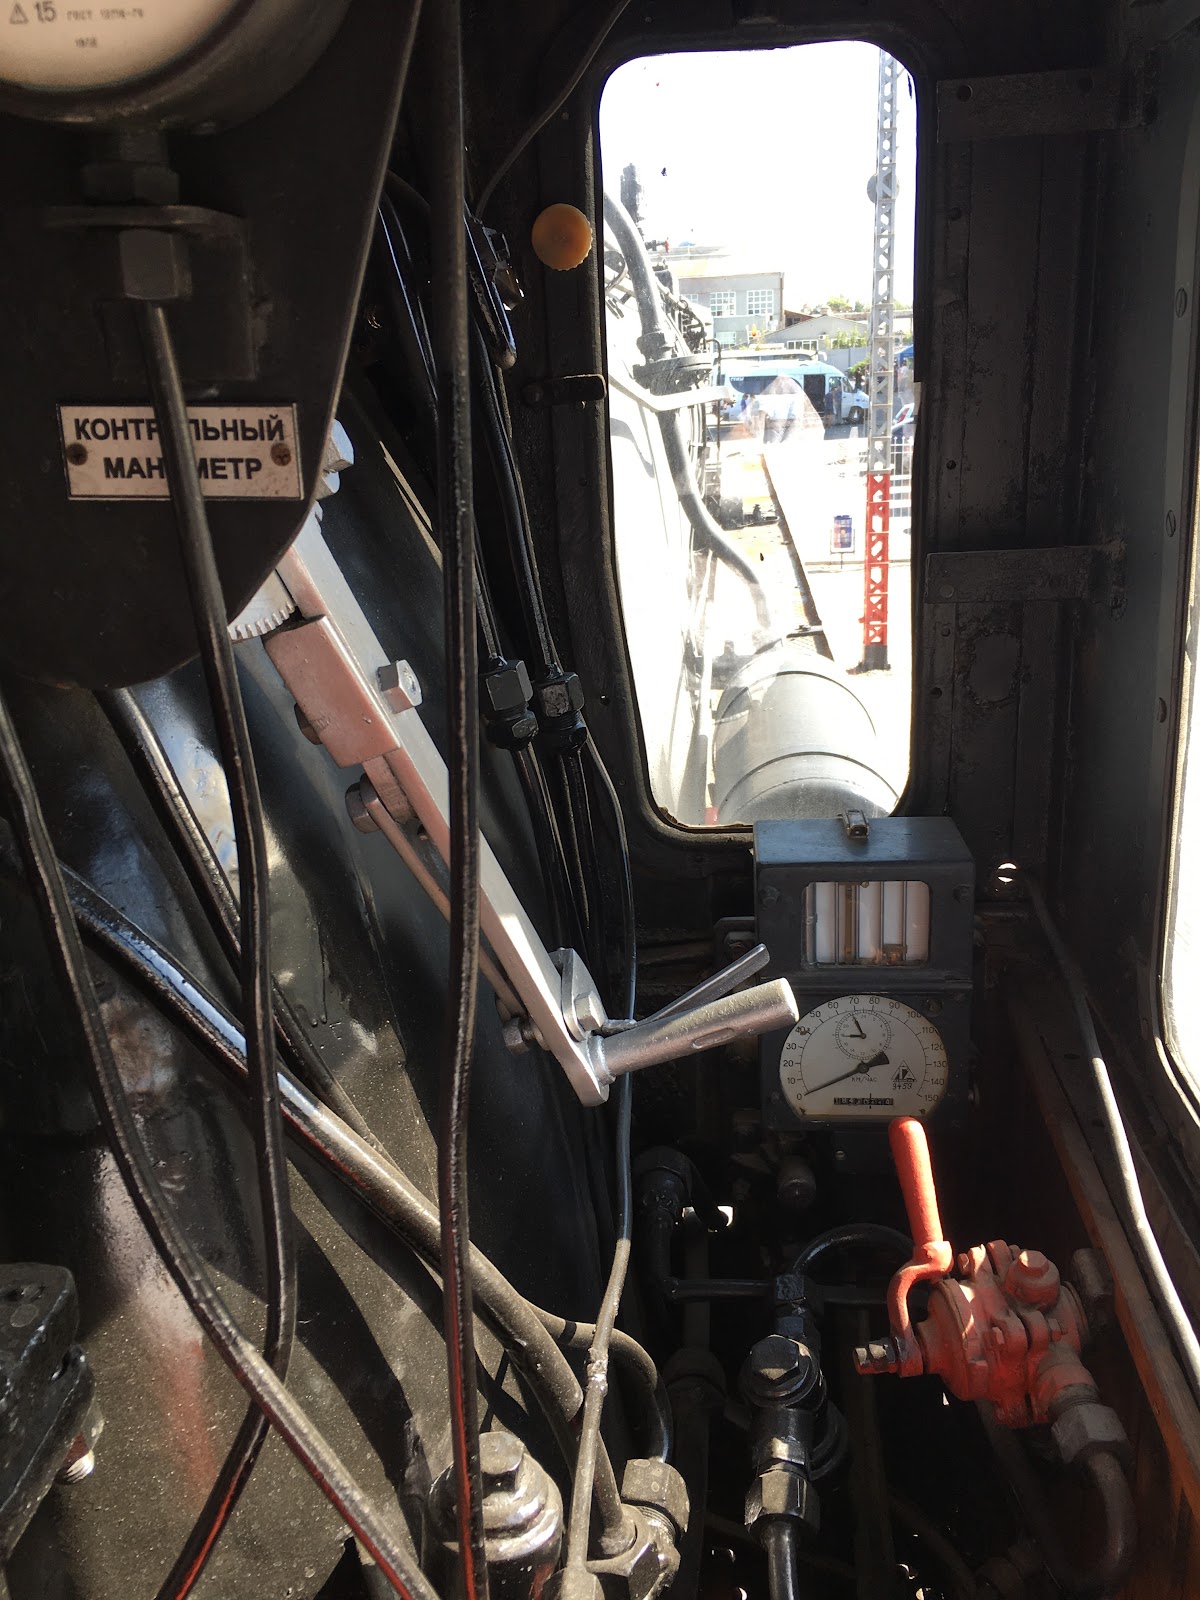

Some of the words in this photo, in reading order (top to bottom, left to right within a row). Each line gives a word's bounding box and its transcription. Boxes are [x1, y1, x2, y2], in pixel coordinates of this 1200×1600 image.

[74, 414, 285, 441] КОНТРЛЬНЫЙ
[103, 456, 262, 480] МАНМЕТР
[795, 1025, 806, 1034] 40
[922, 1026, 935, 1034] 110
[931, 1043, 945, 1051] 120
[933, 1060, 947, 1068] 130
[851, 1076, 878, 1084] КМ/ЧАС
[931, 1078, 945, 1086] 140
[796, 1093, 802, 1101] 0
[924, 1094, 939, 1102] 150
